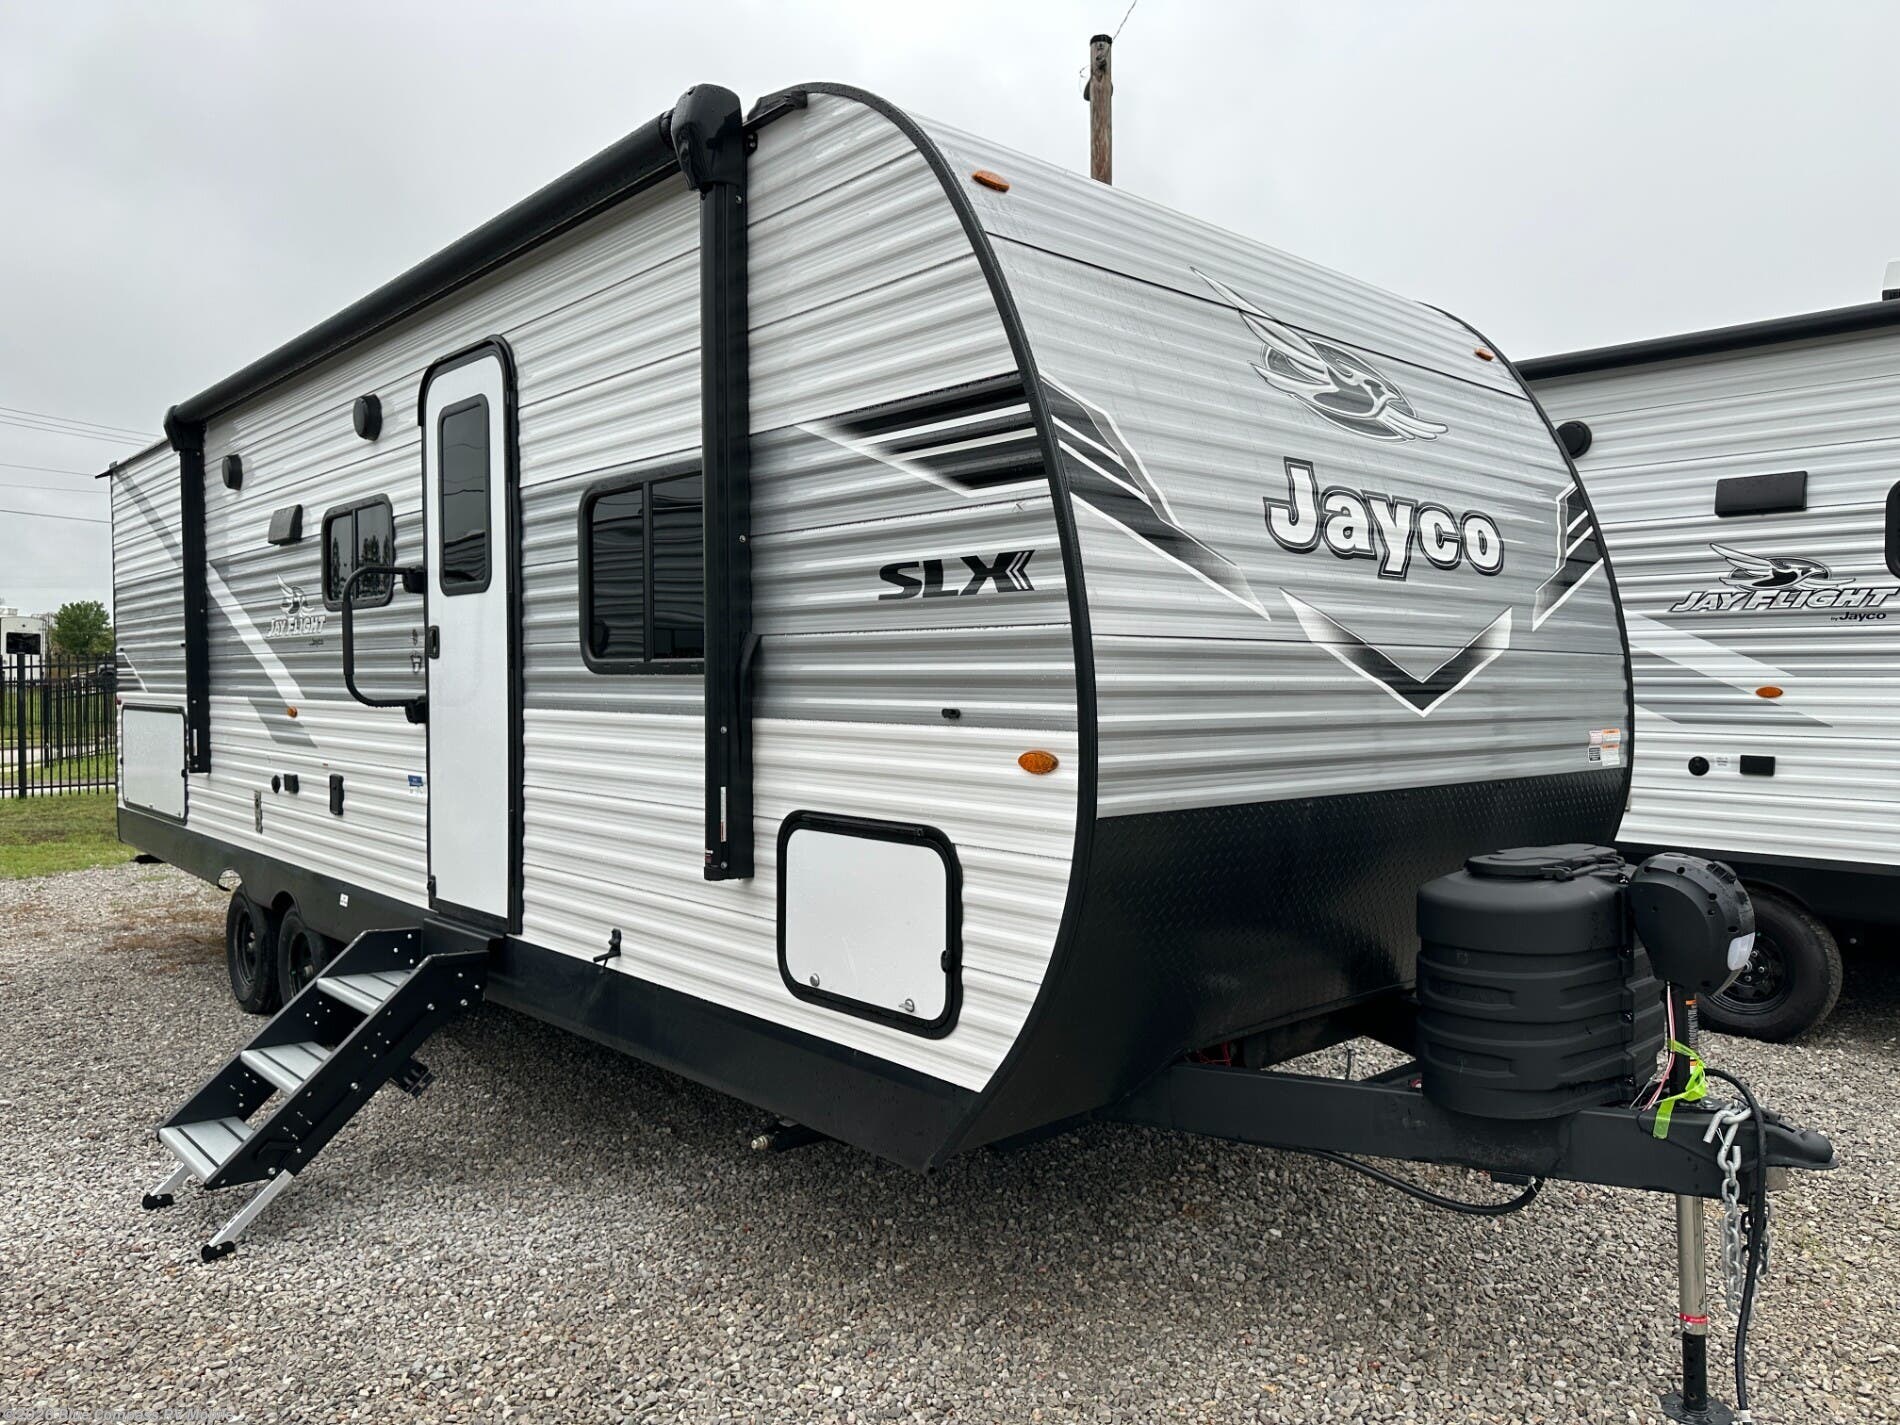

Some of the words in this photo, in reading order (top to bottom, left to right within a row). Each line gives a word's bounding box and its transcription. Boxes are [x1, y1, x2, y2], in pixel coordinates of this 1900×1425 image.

[1263, 456, 1504, 581] Jayco
[878, 549, 1035, 600] SLX
[1668, 591, 1750, 613] JAY
[1744, 586, 1900, 610] FLIGHT
[266, 618, 289, 638] JAY
[287, 615, 326, 636] FLIGHT
[1839, 611, 1887, 622] Jayco
